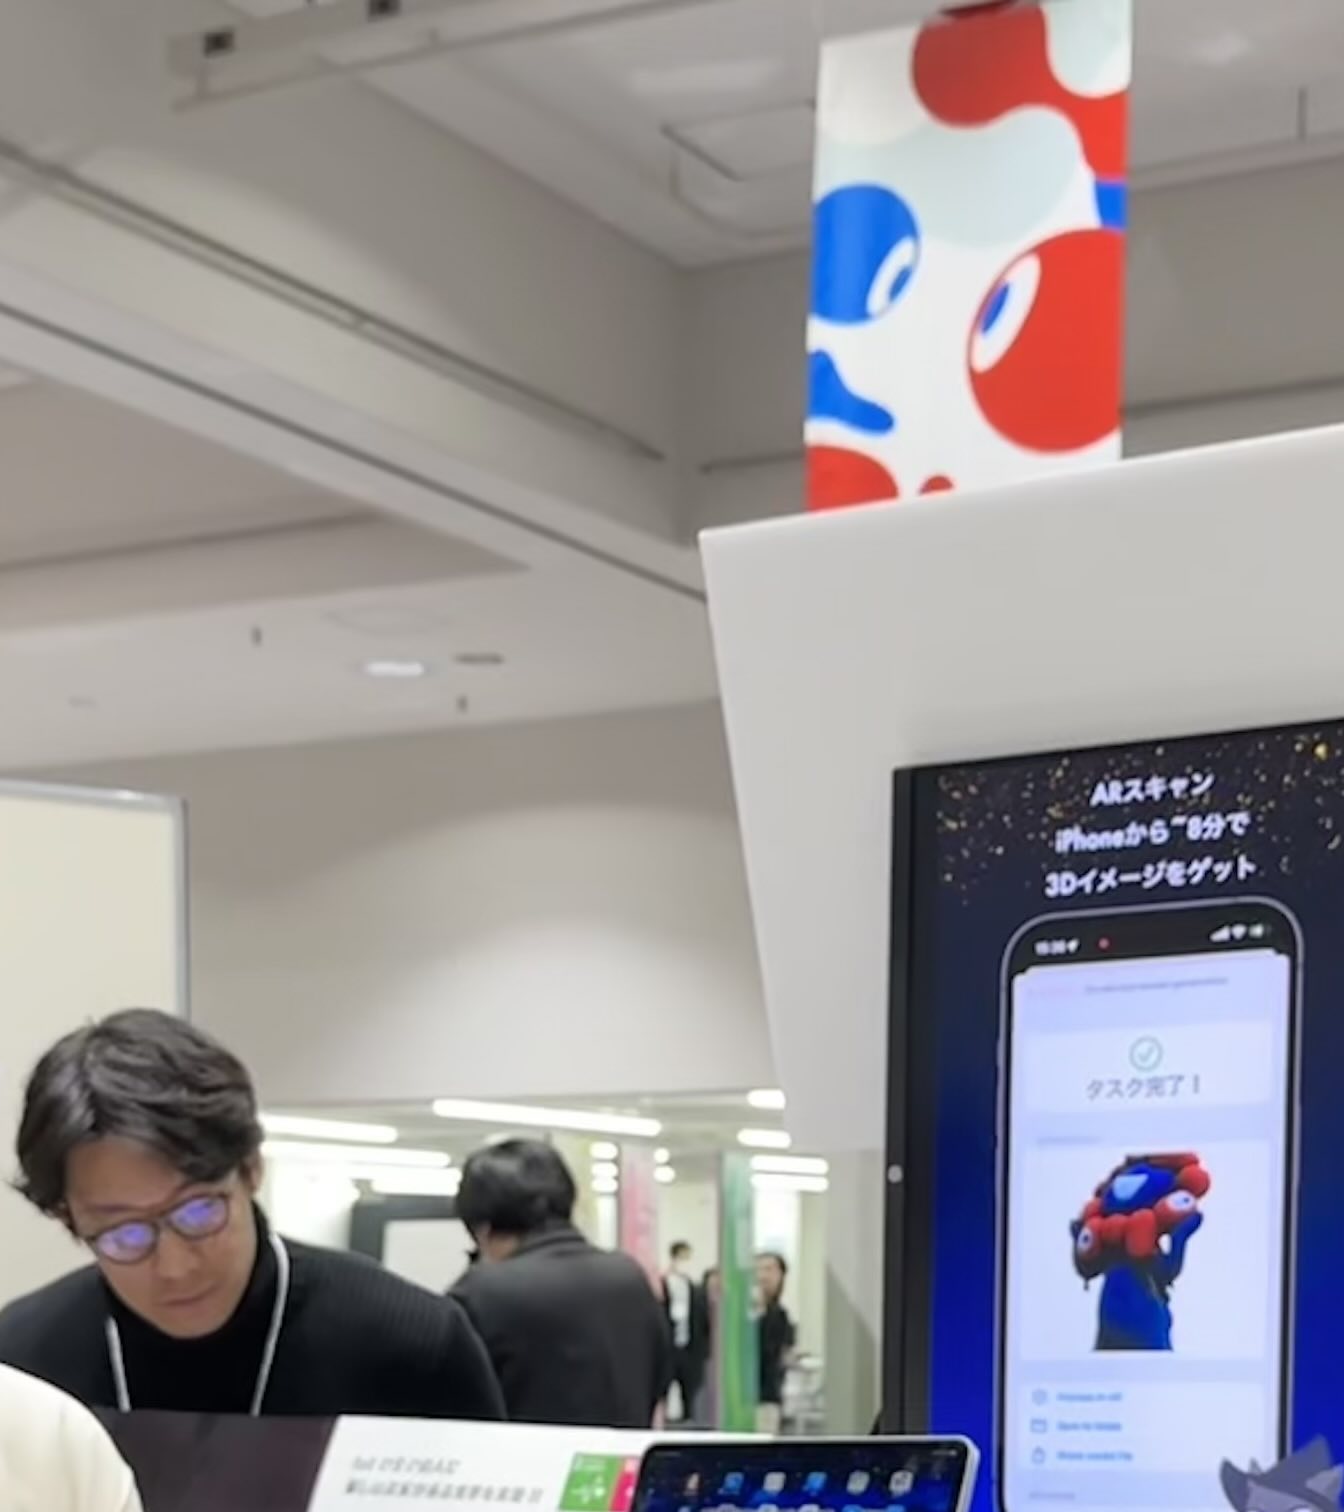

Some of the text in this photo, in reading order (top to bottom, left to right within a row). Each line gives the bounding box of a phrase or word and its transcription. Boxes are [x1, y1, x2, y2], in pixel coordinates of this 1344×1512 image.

[1090, 772, 1215, 807] ARスキャン
[1044, 854, 1257, 898] 3Dイメージをゲット
